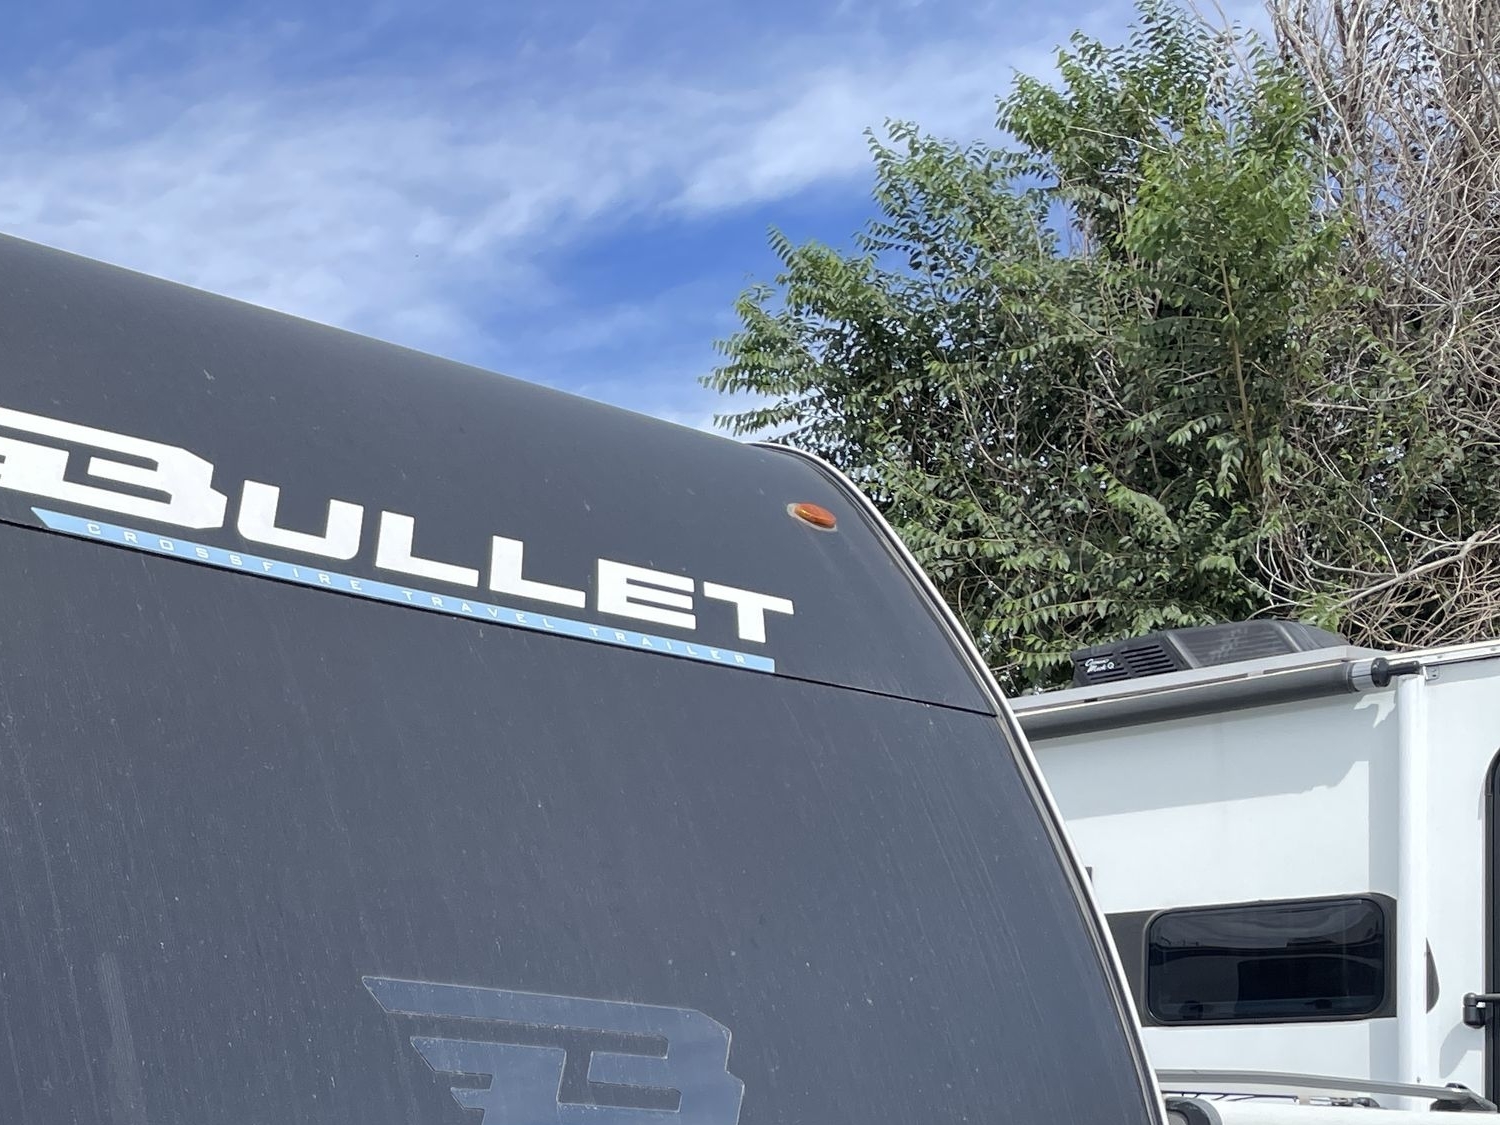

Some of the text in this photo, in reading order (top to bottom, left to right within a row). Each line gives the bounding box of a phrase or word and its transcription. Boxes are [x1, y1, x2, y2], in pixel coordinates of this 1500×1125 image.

[87, 523, 746, 665] CROSSFIRE TRAVEL TRAILER
